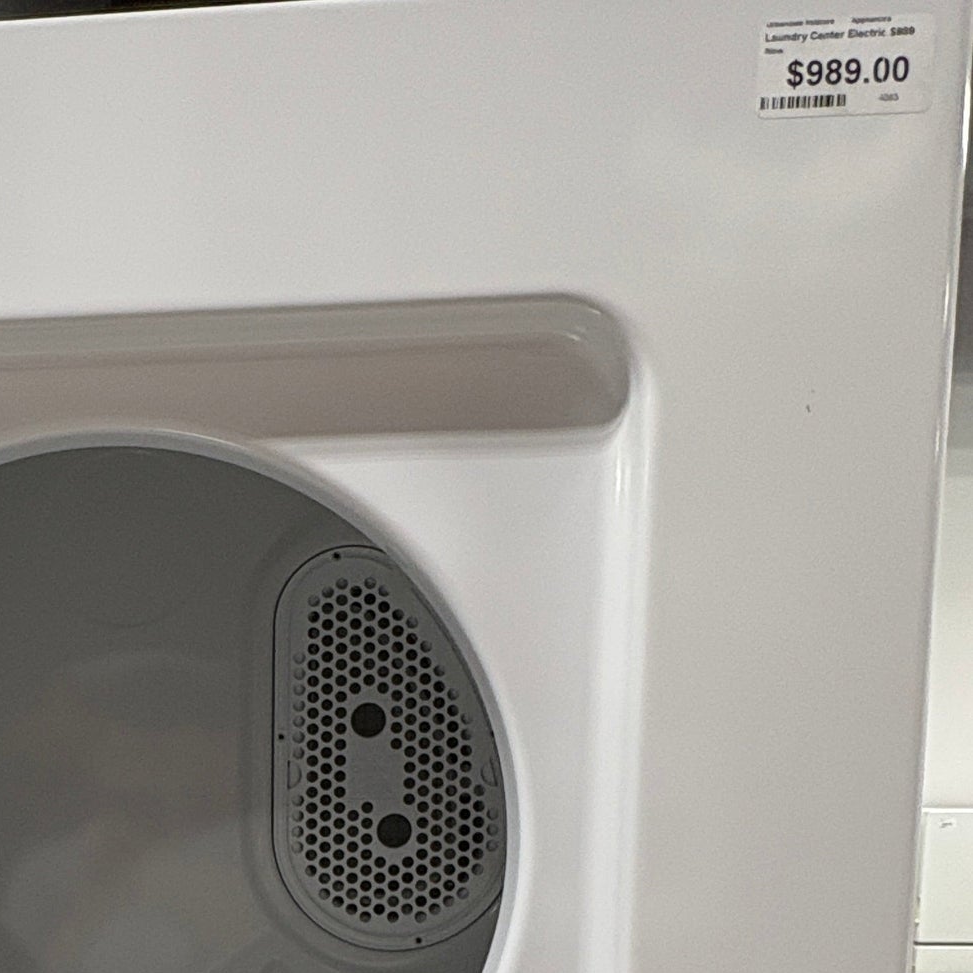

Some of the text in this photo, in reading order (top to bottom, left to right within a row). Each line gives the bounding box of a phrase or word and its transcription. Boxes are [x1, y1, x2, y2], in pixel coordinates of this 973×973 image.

[765, 31, 808, 43] Laundry
[810, 30, 844, 41] Center
[847, 28, 886, 39] Electric
[786, 55, 910, 90] $989.00
